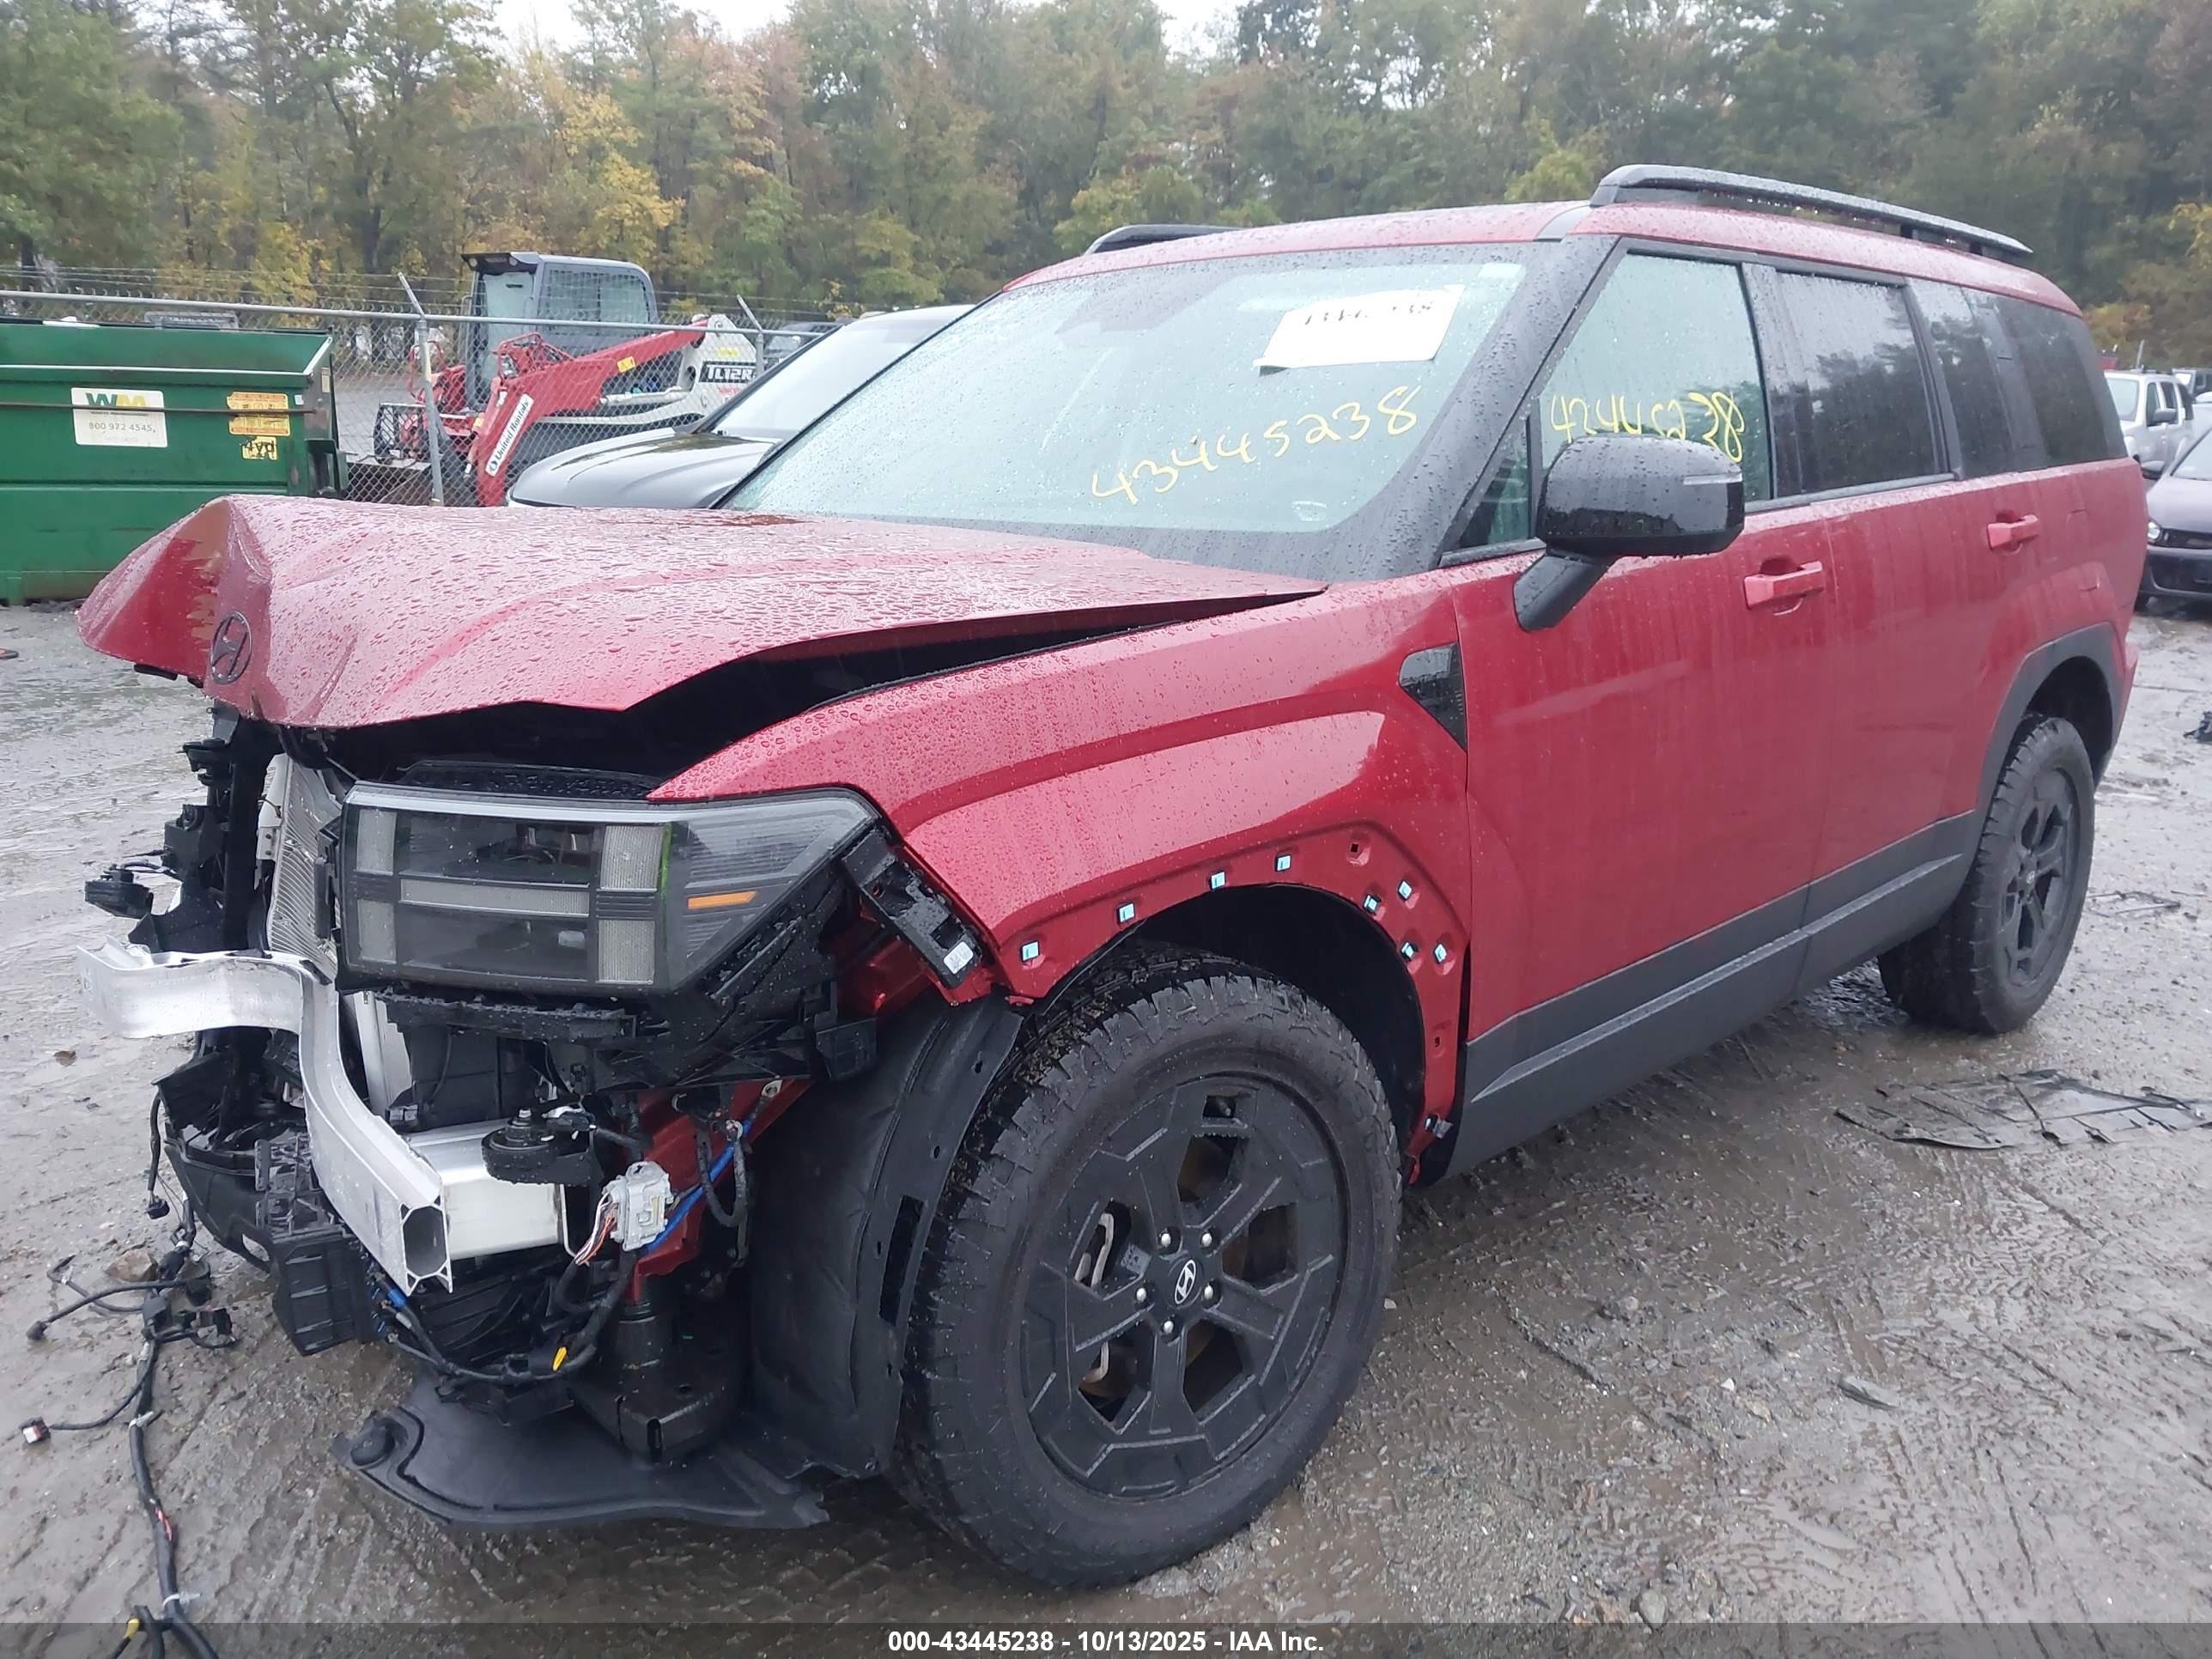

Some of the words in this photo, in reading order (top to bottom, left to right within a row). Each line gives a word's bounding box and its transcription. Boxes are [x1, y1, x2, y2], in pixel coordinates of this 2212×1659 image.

[706, 364, 757, 380] TL12R
[85, 392, 147, 407] WM
[89, 422, 106, 430] 800
[108, 422, 125, 431] 972
[495, 429, 514, 460] United
[510, 400, 530, 432] Rentals
[1091, 385, 1423, 505] 43445238
